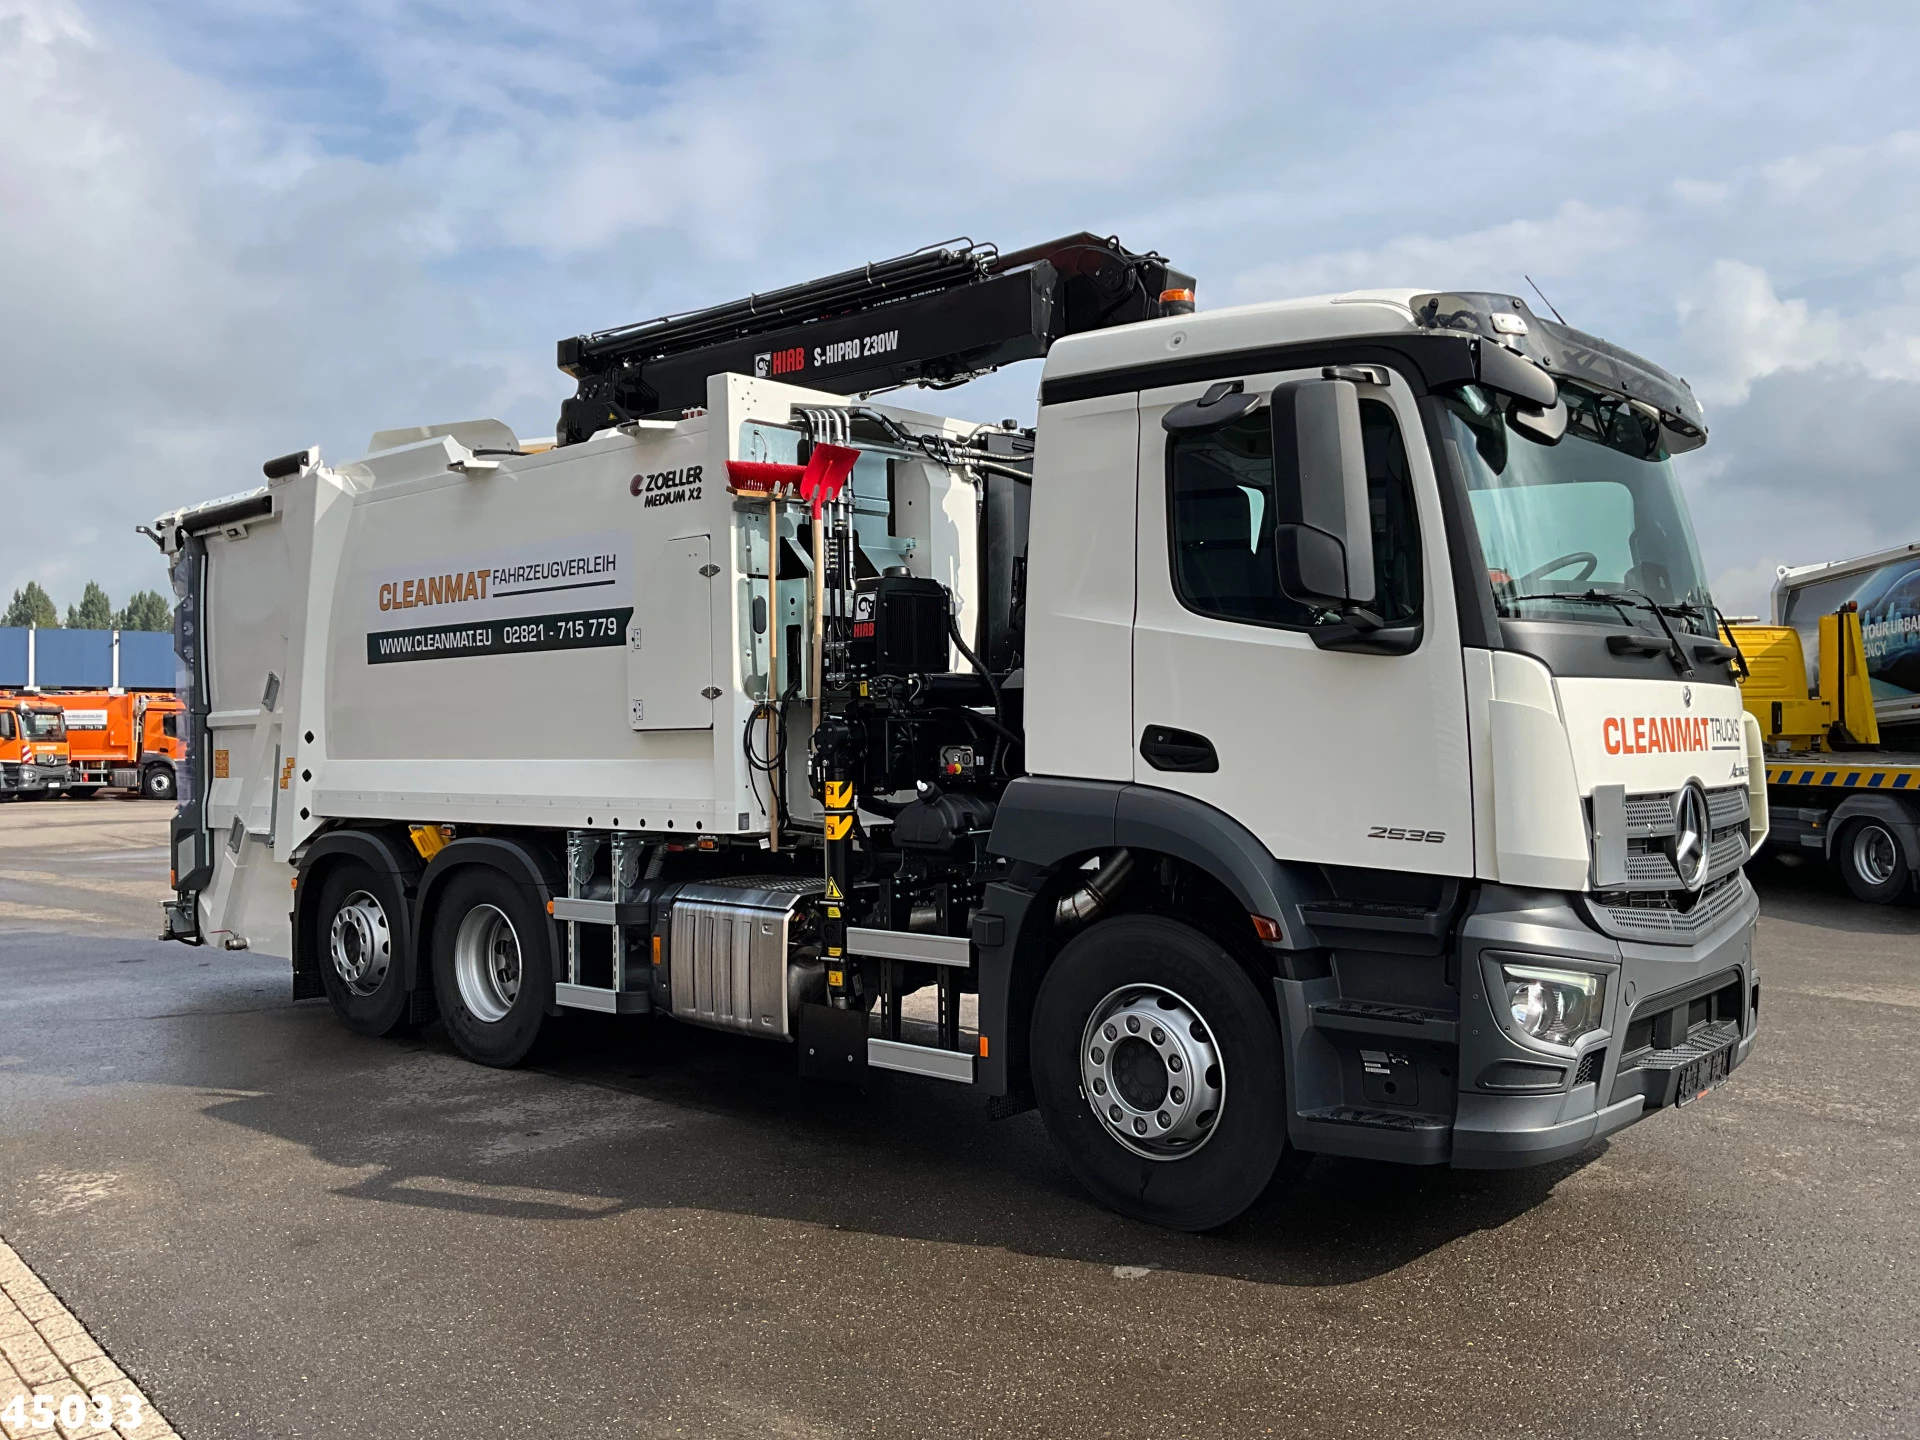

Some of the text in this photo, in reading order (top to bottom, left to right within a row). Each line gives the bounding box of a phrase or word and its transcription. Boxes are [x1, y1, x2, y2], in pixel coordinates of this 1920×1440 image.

[772, 330, 898, 375] HIAB S-HIPRO 230W
[645, 465, 703, 492] ZOELLER
[644, 486, 702, 508] MEDIUM X2
[379, 554, 617, 612] CLEANMAT FAHRZEUGVERLEIH
[379, 629, 492, 655] WWW.CLEANMAT.EU
[504, 623, 545, 645] 02821
[557, 621, 584, 640] 715
[588, 617, 617, 637] 779
[854, 622, 875, 638] HIAB
[1863, 621, 1889, 639] YOUR
[1603, 717, 1741, 755] CLEANMAT TRUCKS
[1367, 826, 1447, 844] 2536
